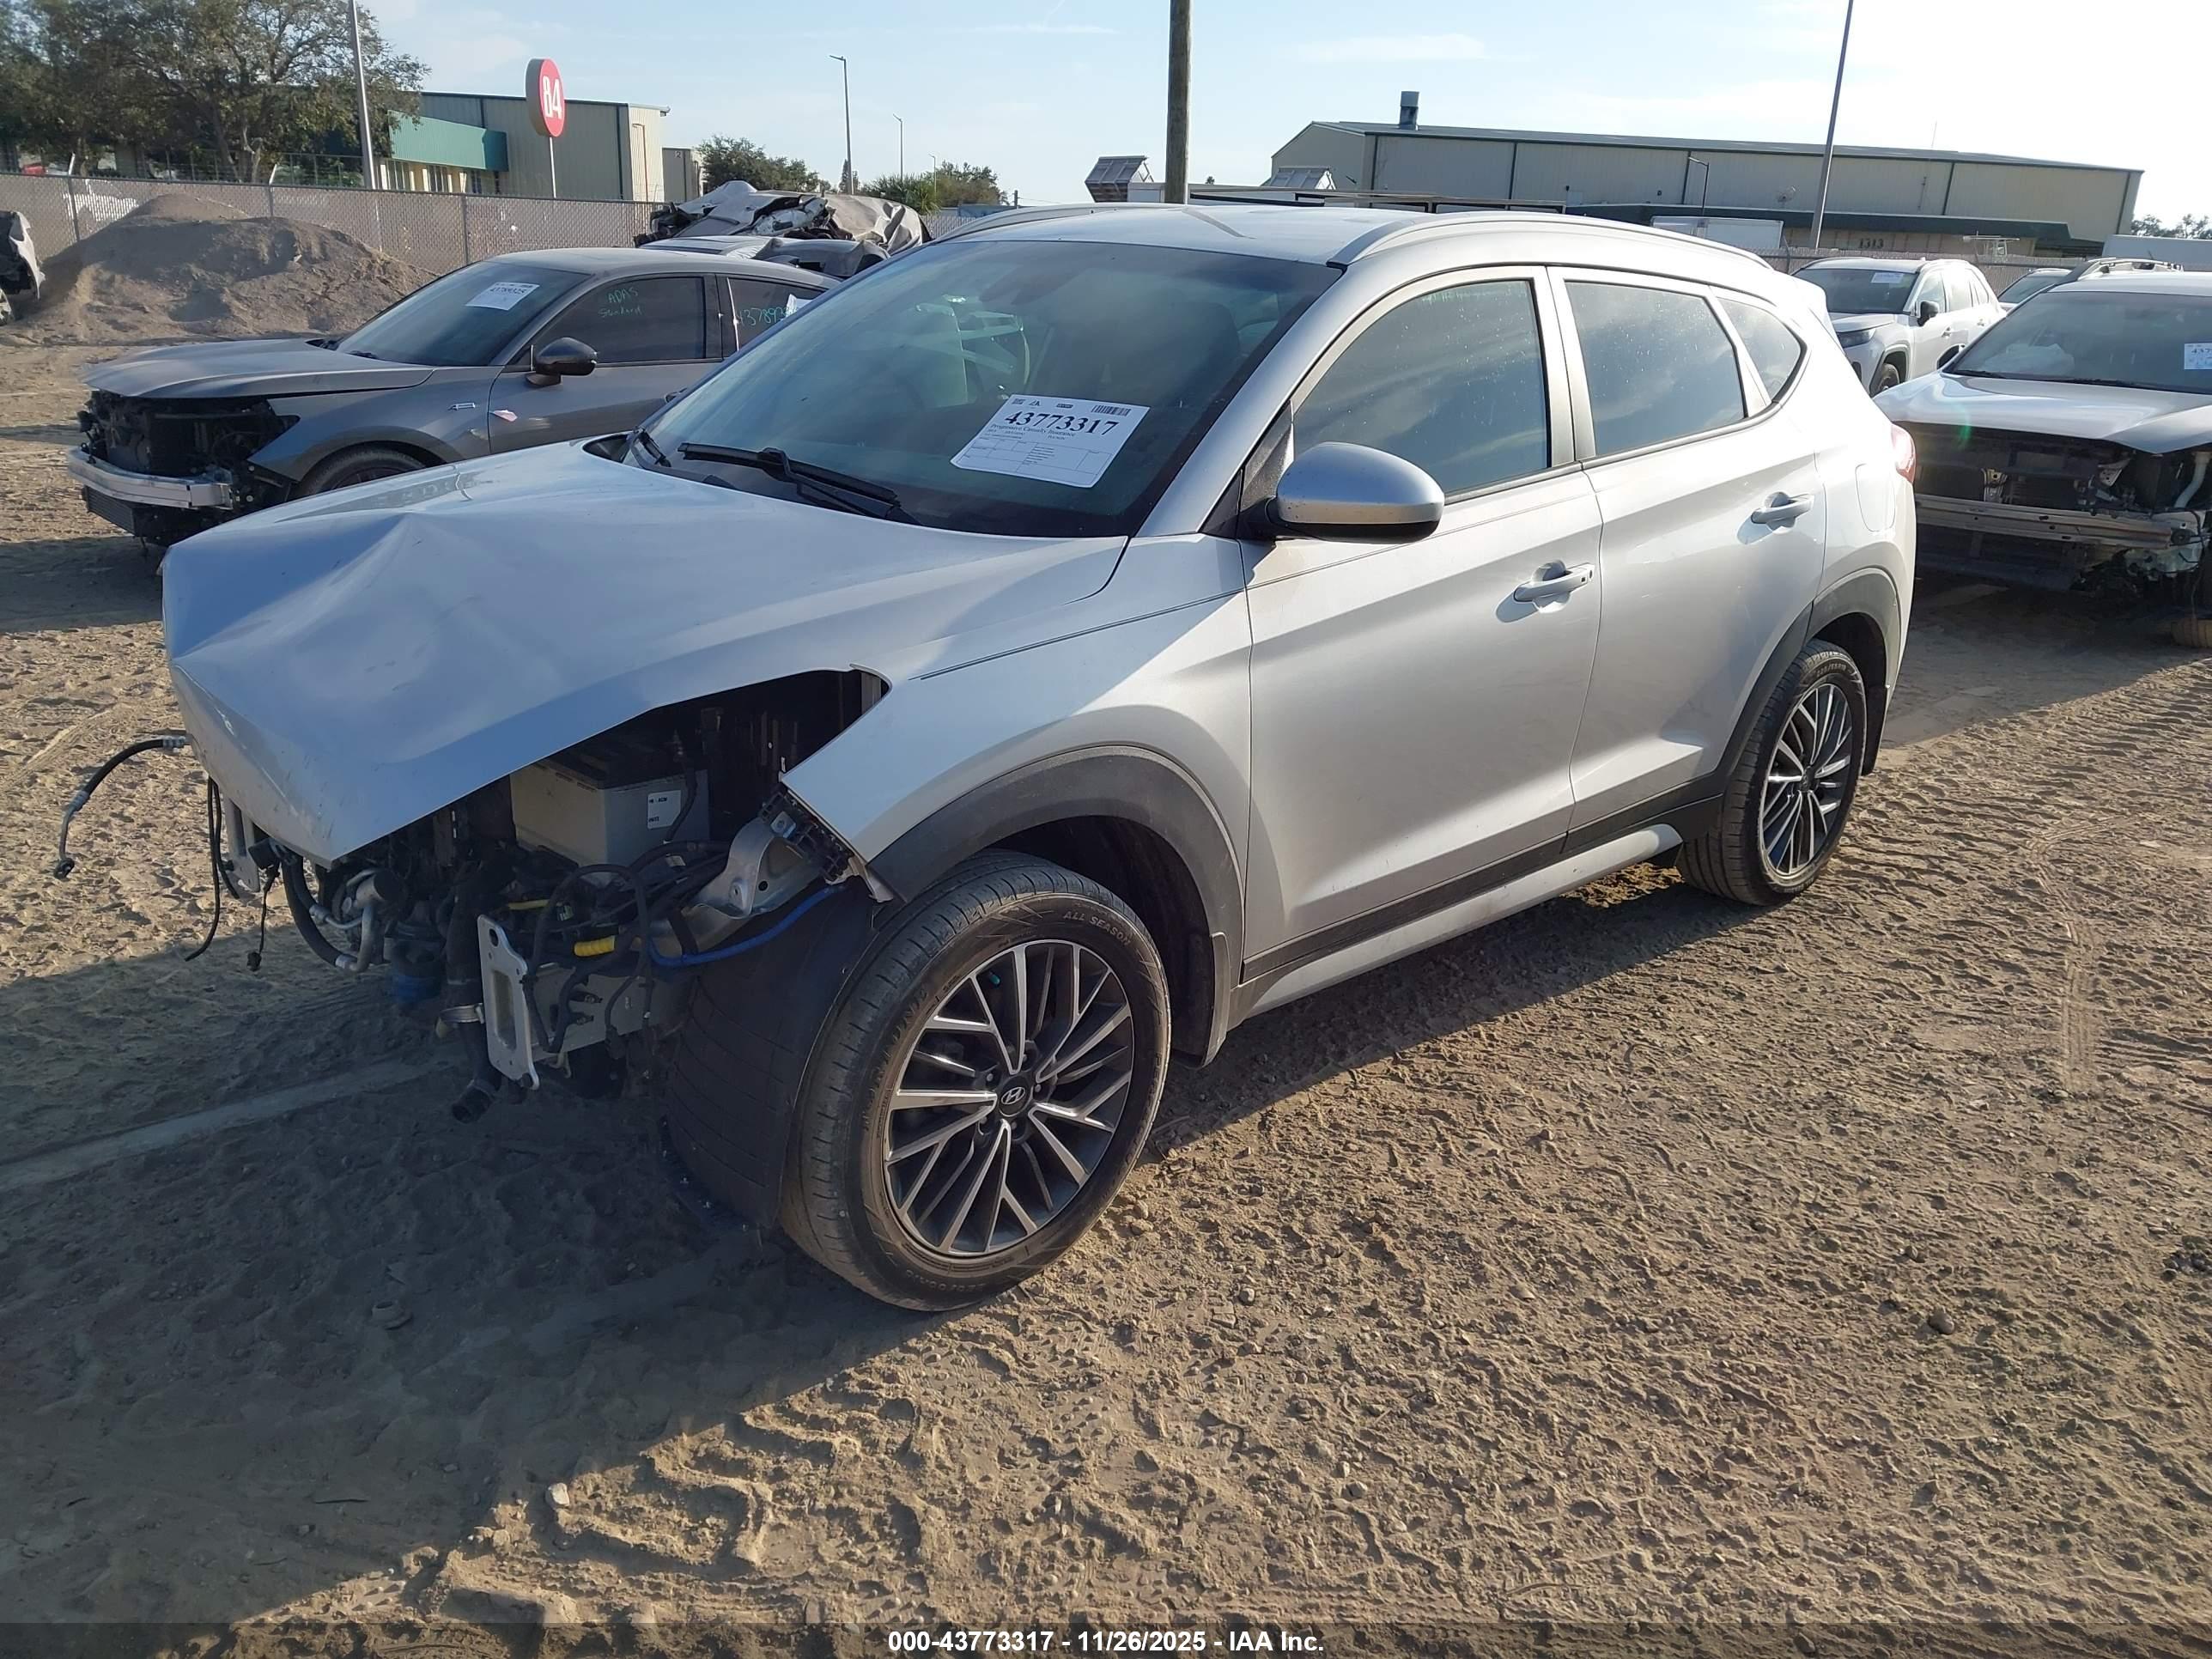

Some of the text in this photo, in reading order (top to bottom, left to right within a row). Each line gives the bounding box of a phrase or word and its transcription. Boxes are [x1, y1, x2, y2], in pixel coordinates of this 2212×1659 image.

[543, 75, 563, 119] 84
[1858, 238, 1884, 249] 1313
[1004, 410, 1120, 435] 43773317
[1063, 911, 1131, 945] ALL SEASON
